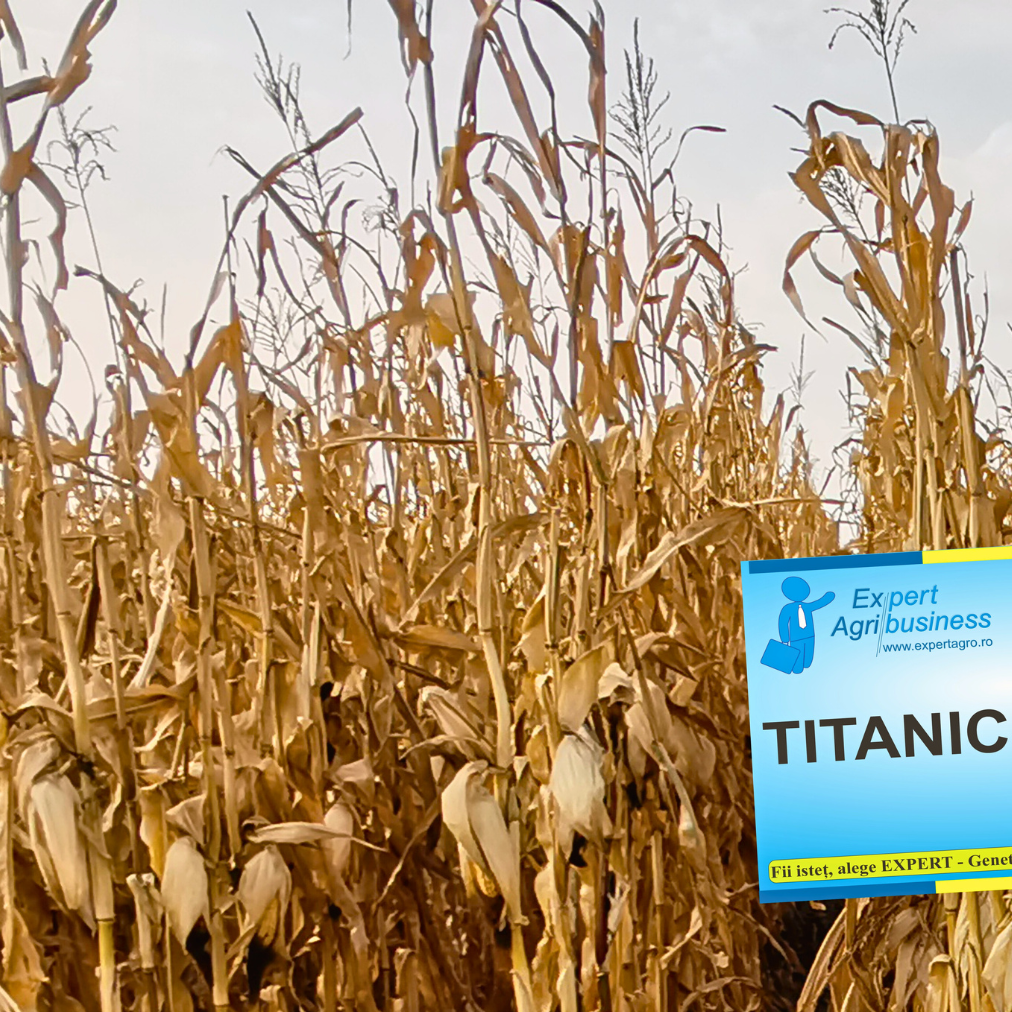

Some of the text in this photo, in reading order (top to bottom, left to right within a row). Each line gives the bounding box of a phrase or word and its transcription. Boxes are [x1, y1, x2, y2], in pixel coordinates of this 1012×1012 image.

[852, 584, 939, 612] Expert
[883, 638, 994, 653] www.expertagro.ro
[763, 708, 1009, 765] TITANIC
[771, 865, 792, 879] Fii
[796, 864, 834, 879] isteț,
[837, 861, 877, 877] alege
[881, 855, 953, 872] EXPERT
